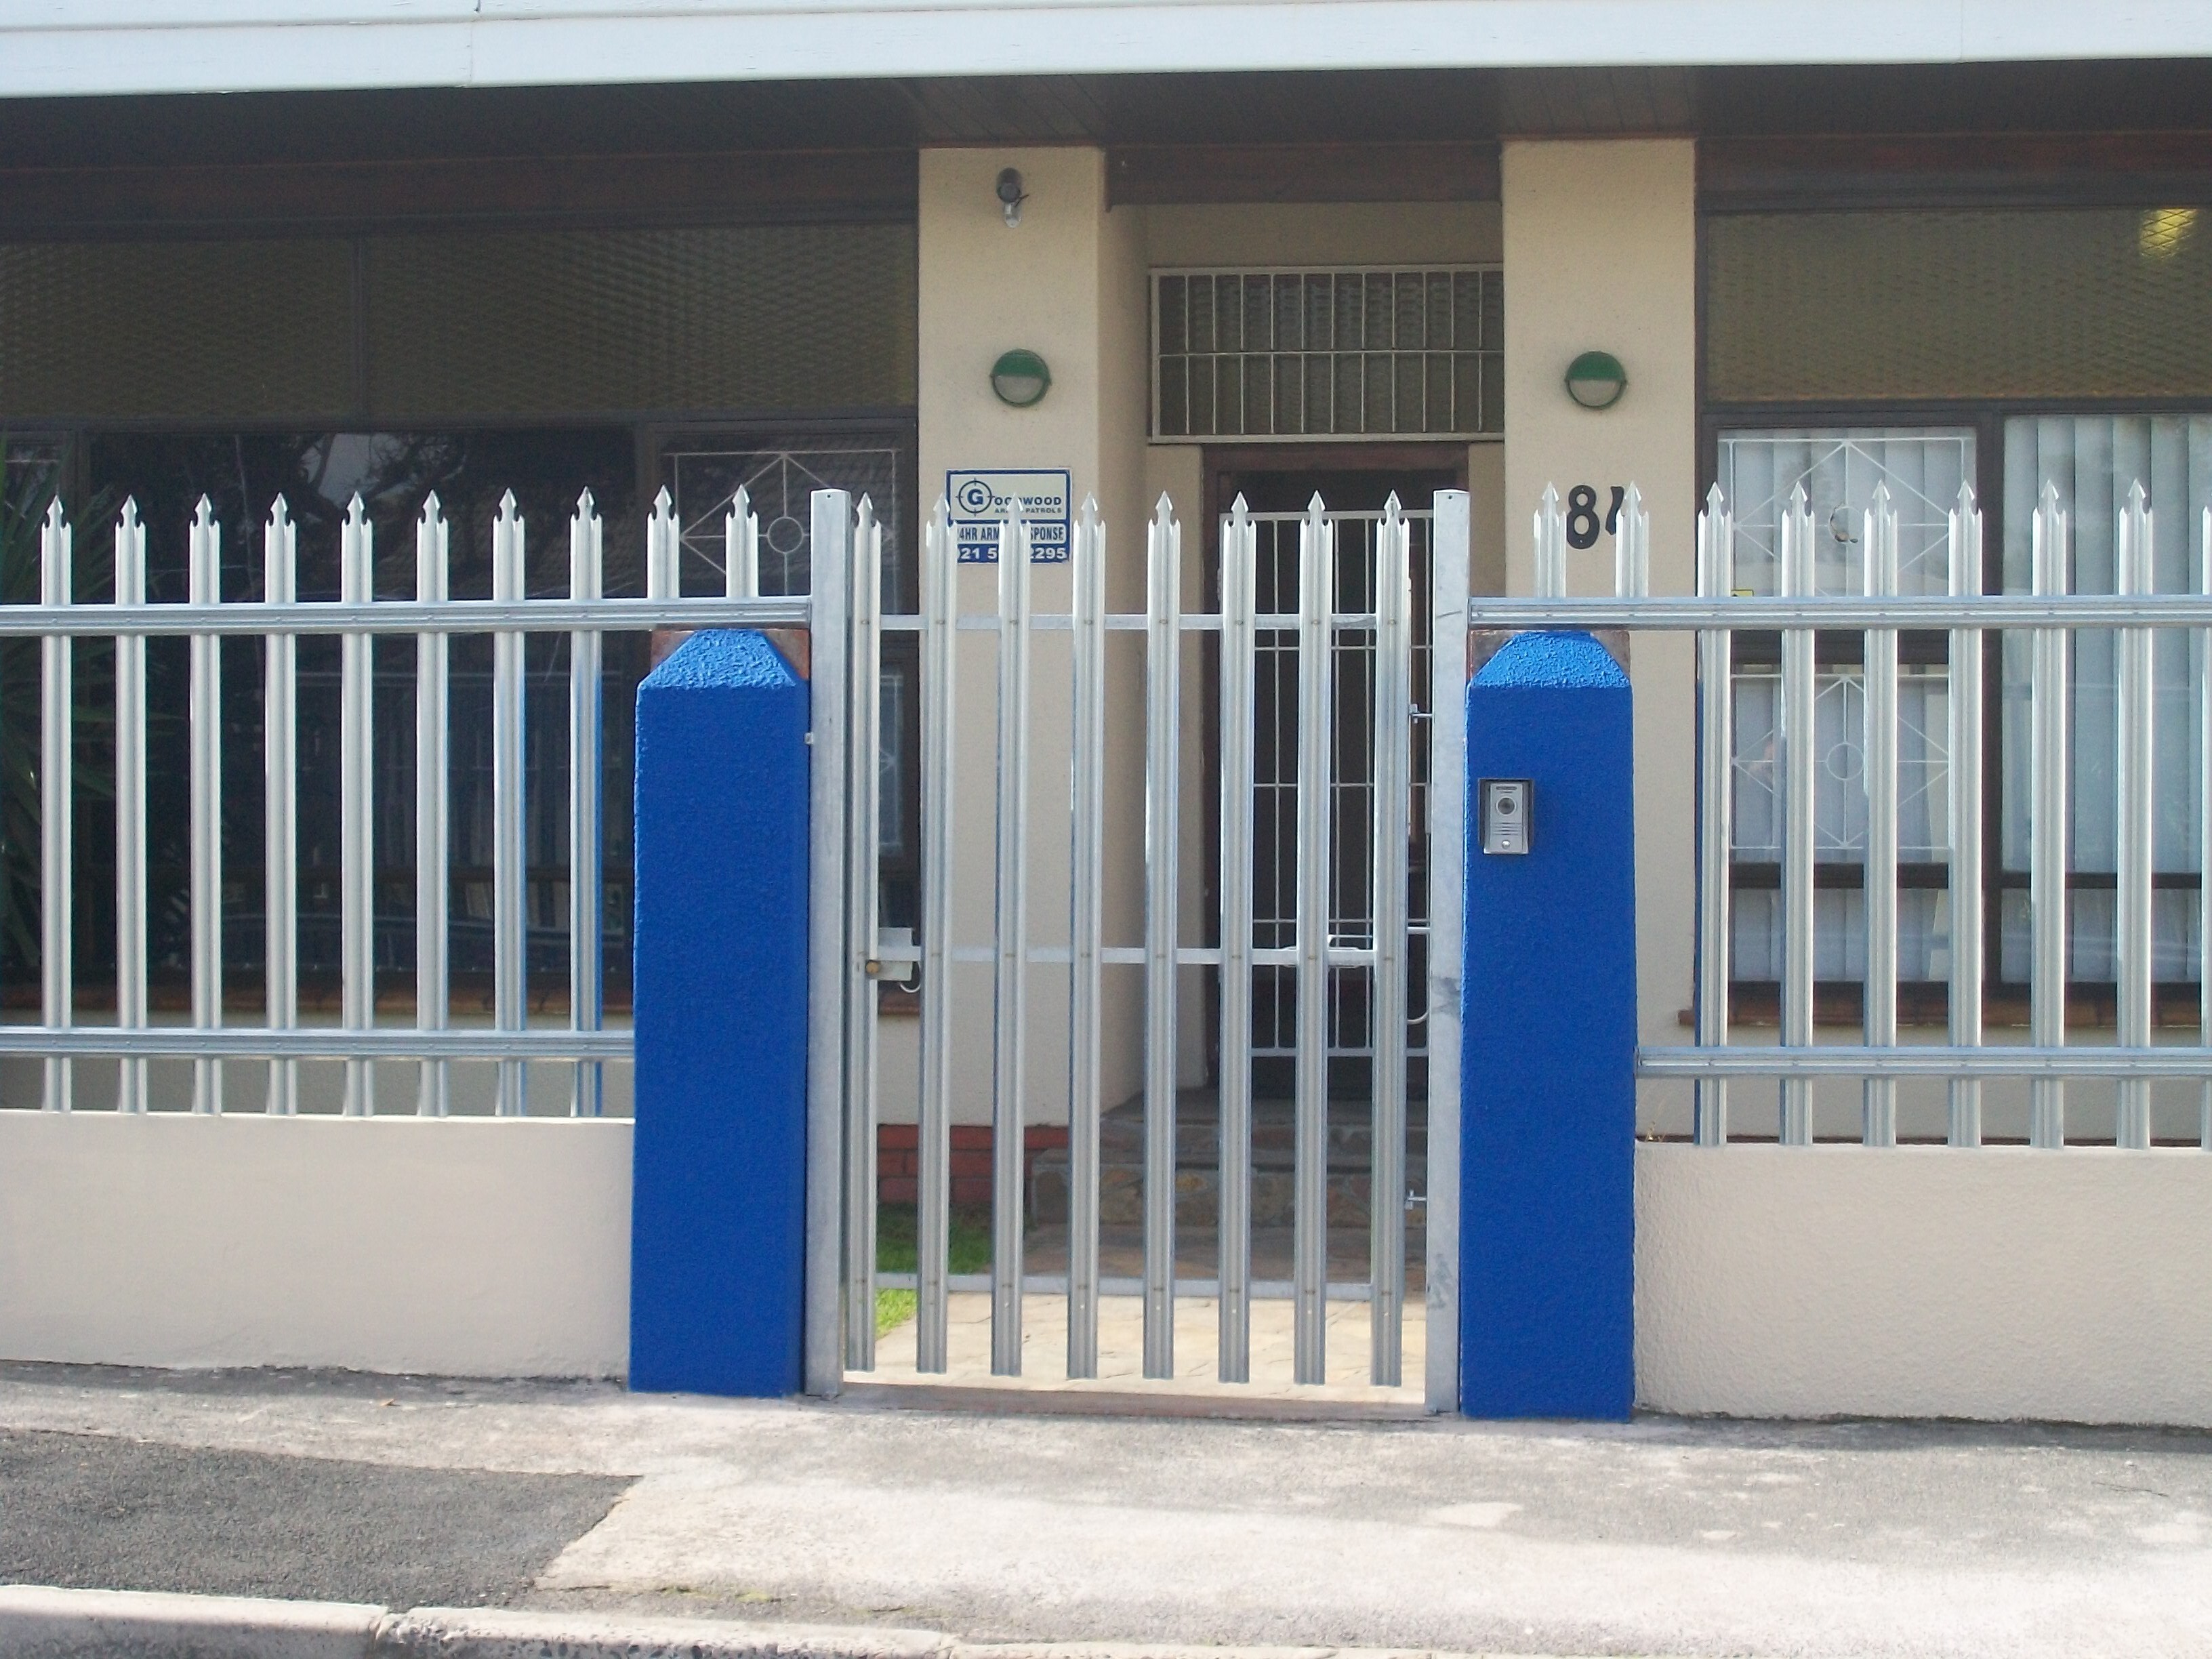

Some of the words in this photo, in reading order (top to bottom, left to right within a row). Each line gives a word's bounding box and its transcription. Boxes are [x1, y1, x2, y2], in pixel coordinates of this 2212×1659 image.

[967, 488, 1062, 506] GOOWOOD
[958, 527, 977, 541] 4HR
[958, 548, 980, 560] 21
